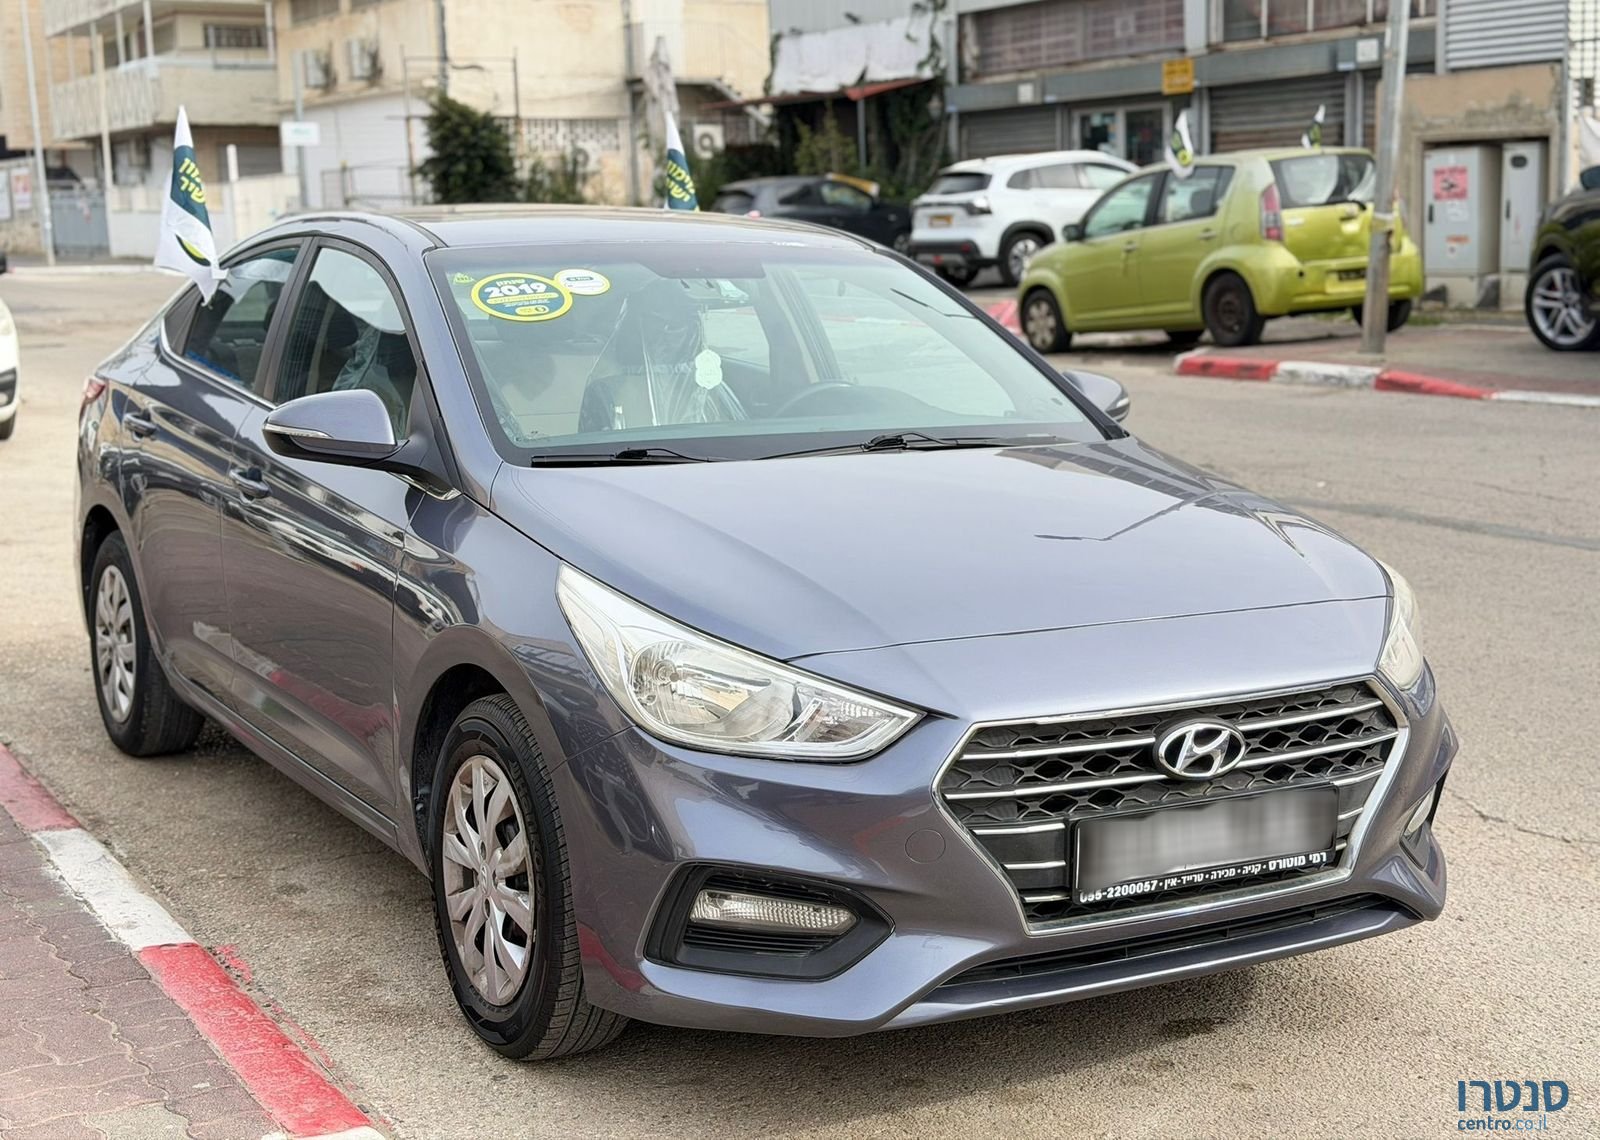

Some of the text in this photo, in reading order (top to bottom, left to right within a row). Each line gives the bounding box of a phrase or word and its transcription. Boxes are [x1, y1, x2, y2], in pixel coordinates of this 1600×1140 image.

[484, 282, 547, 298] 2019
[1268, 855, 1306, 871] מוטורס
[1309, 852, 1327, 864] רמי
[1210, 868, 1236, 880] מכירה
[1242, 863, 1262, 875] קניה
[1163, 873, 1204, 890] טרייד-אין
